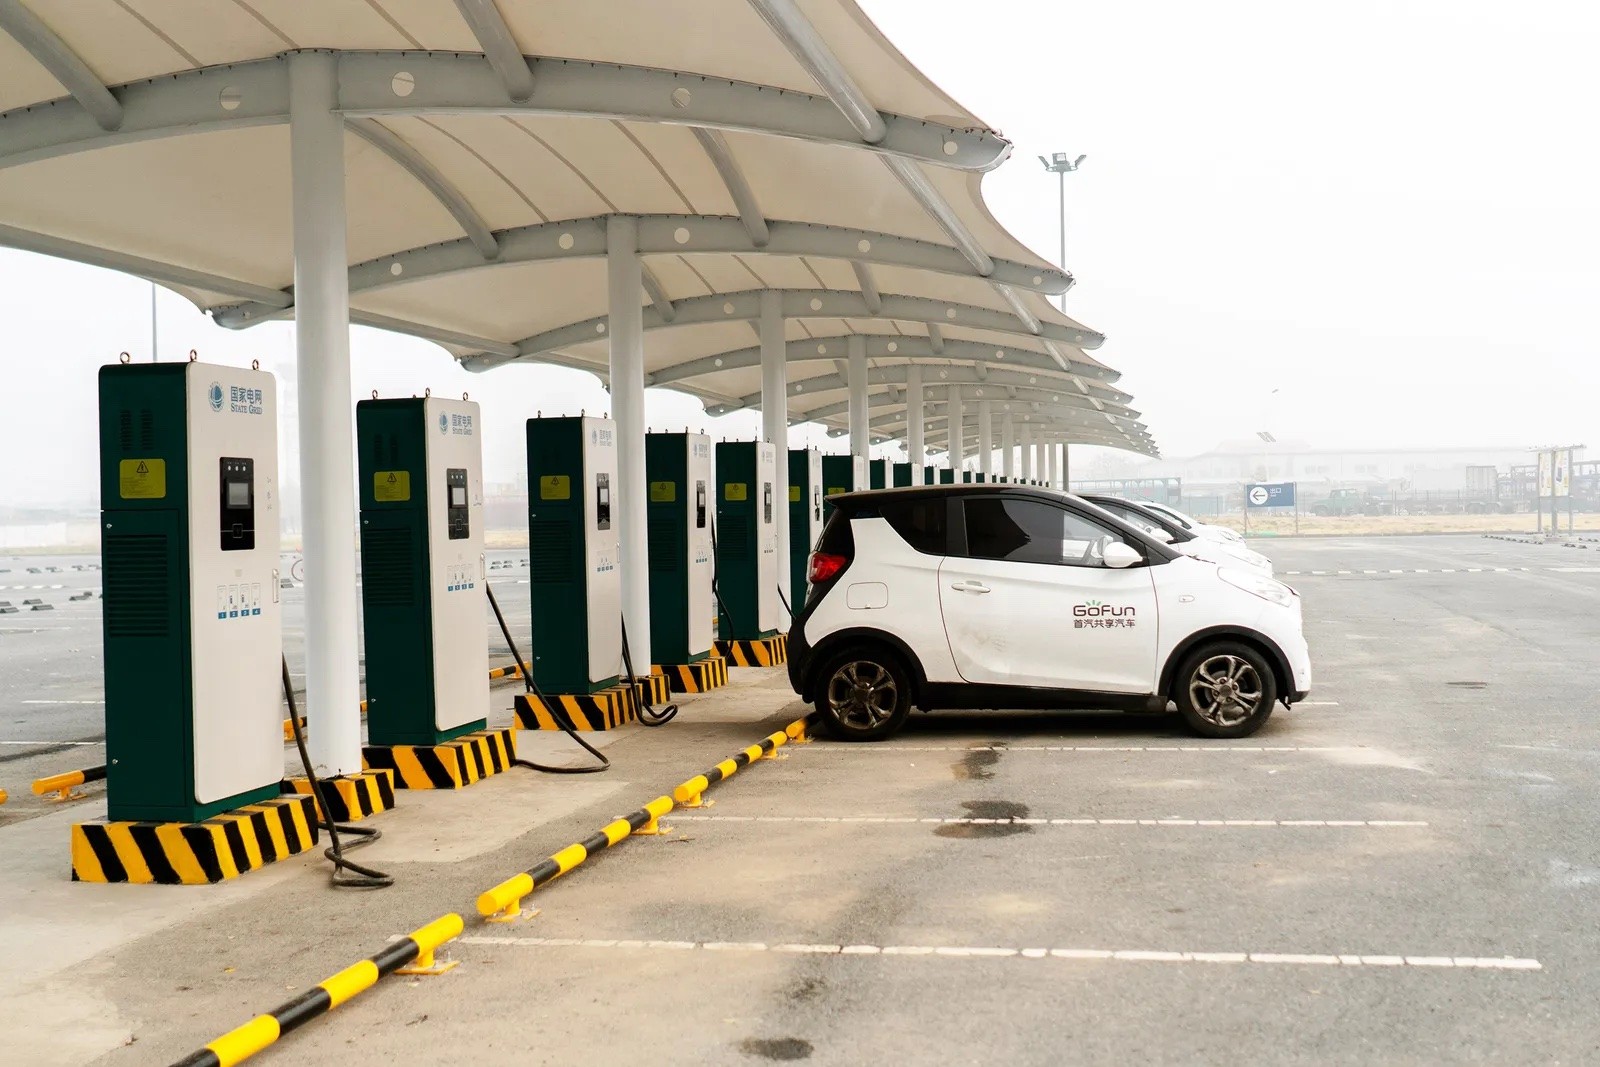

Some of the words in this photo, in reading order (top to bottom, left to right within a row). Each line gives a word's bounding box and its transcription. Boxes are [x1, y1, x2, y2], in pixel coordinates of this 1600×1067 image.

[231, 386, 262, 405] 国家电网
[1073, 618, 1136, 628] 首汽共享汽车
